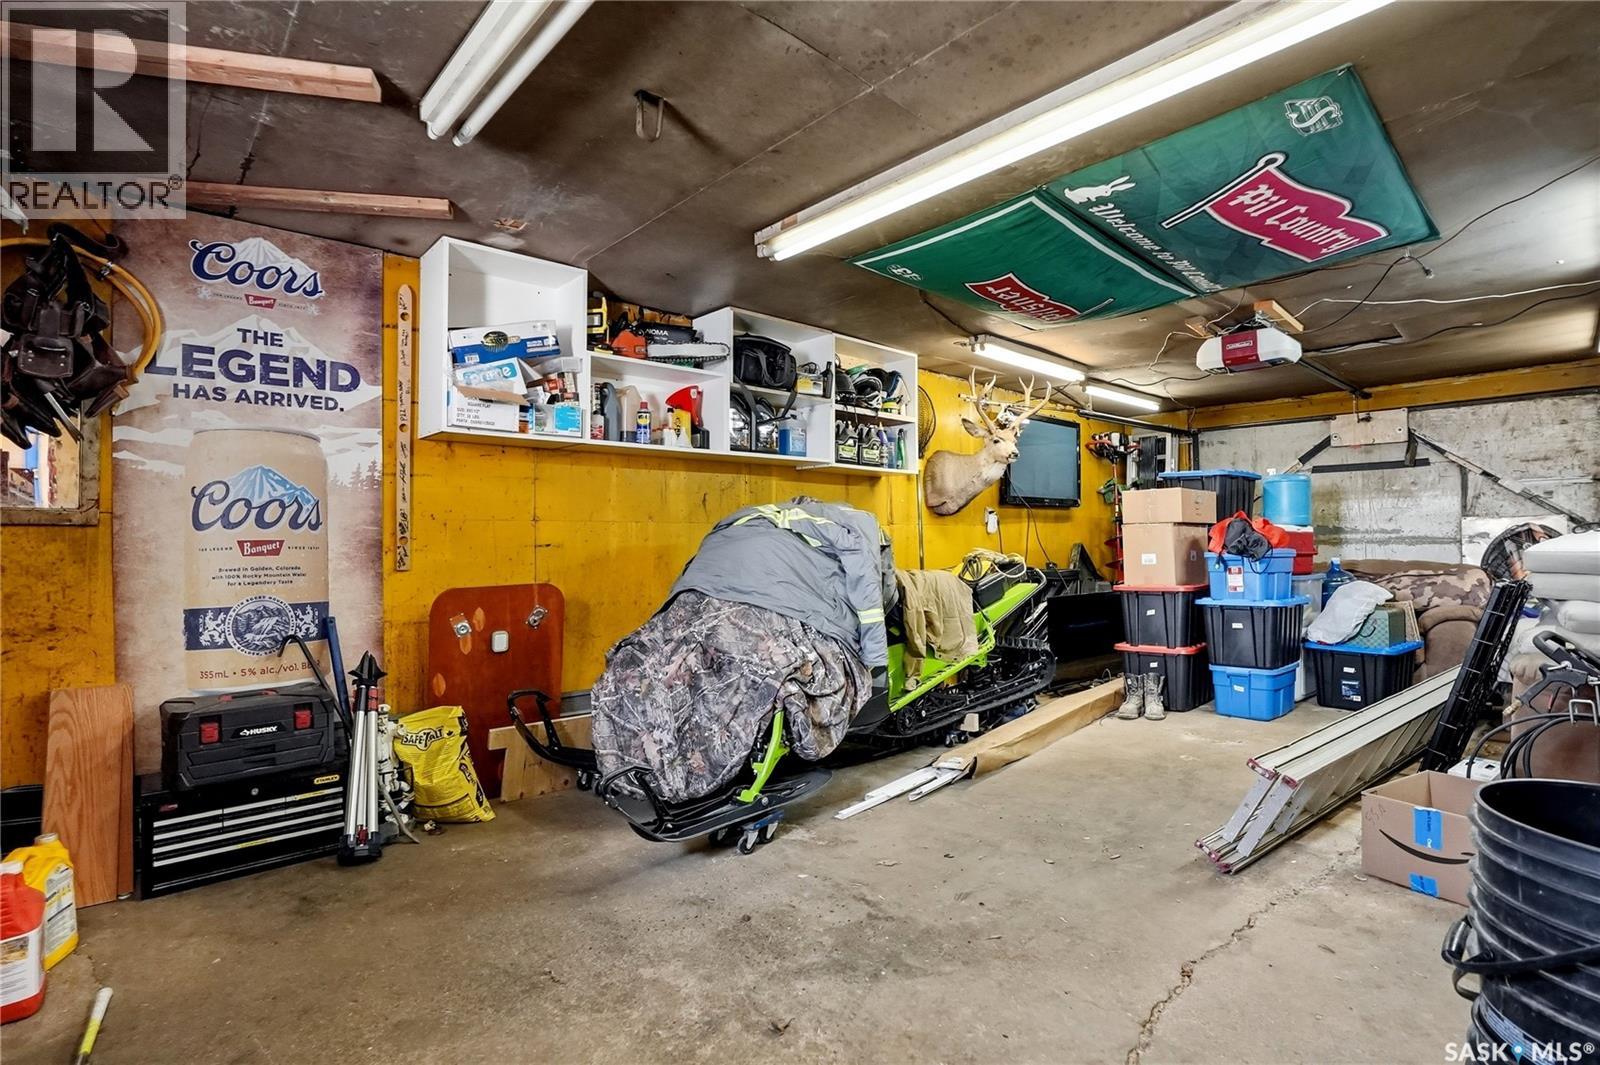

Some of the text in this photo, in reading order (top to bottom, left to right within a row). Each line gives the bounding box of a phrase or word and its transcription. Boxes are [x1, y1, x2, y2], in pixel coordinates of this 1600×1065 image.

[1088, 202, 1161, 250] Welcome
[1264, 205, 1360, 254] Country
[190, 240, 323, 297] Coors
[985, 286, 1069, 322] Pilsner
[237, 328, 284, 347] THE
[144, 343, 361, 393] LEGEND
[173, 383, 345, 412] HAS ARRIVED.
[191, 480, 322, 531] Coors
[243, 541, 280, 555] Banquet
[200, 670, 229, 680] 355mL
[241, 668, 257, 677] 5%
[260, 664, 299, 675] alc./vol.
[249, 725, 278, 735] HUSKY
